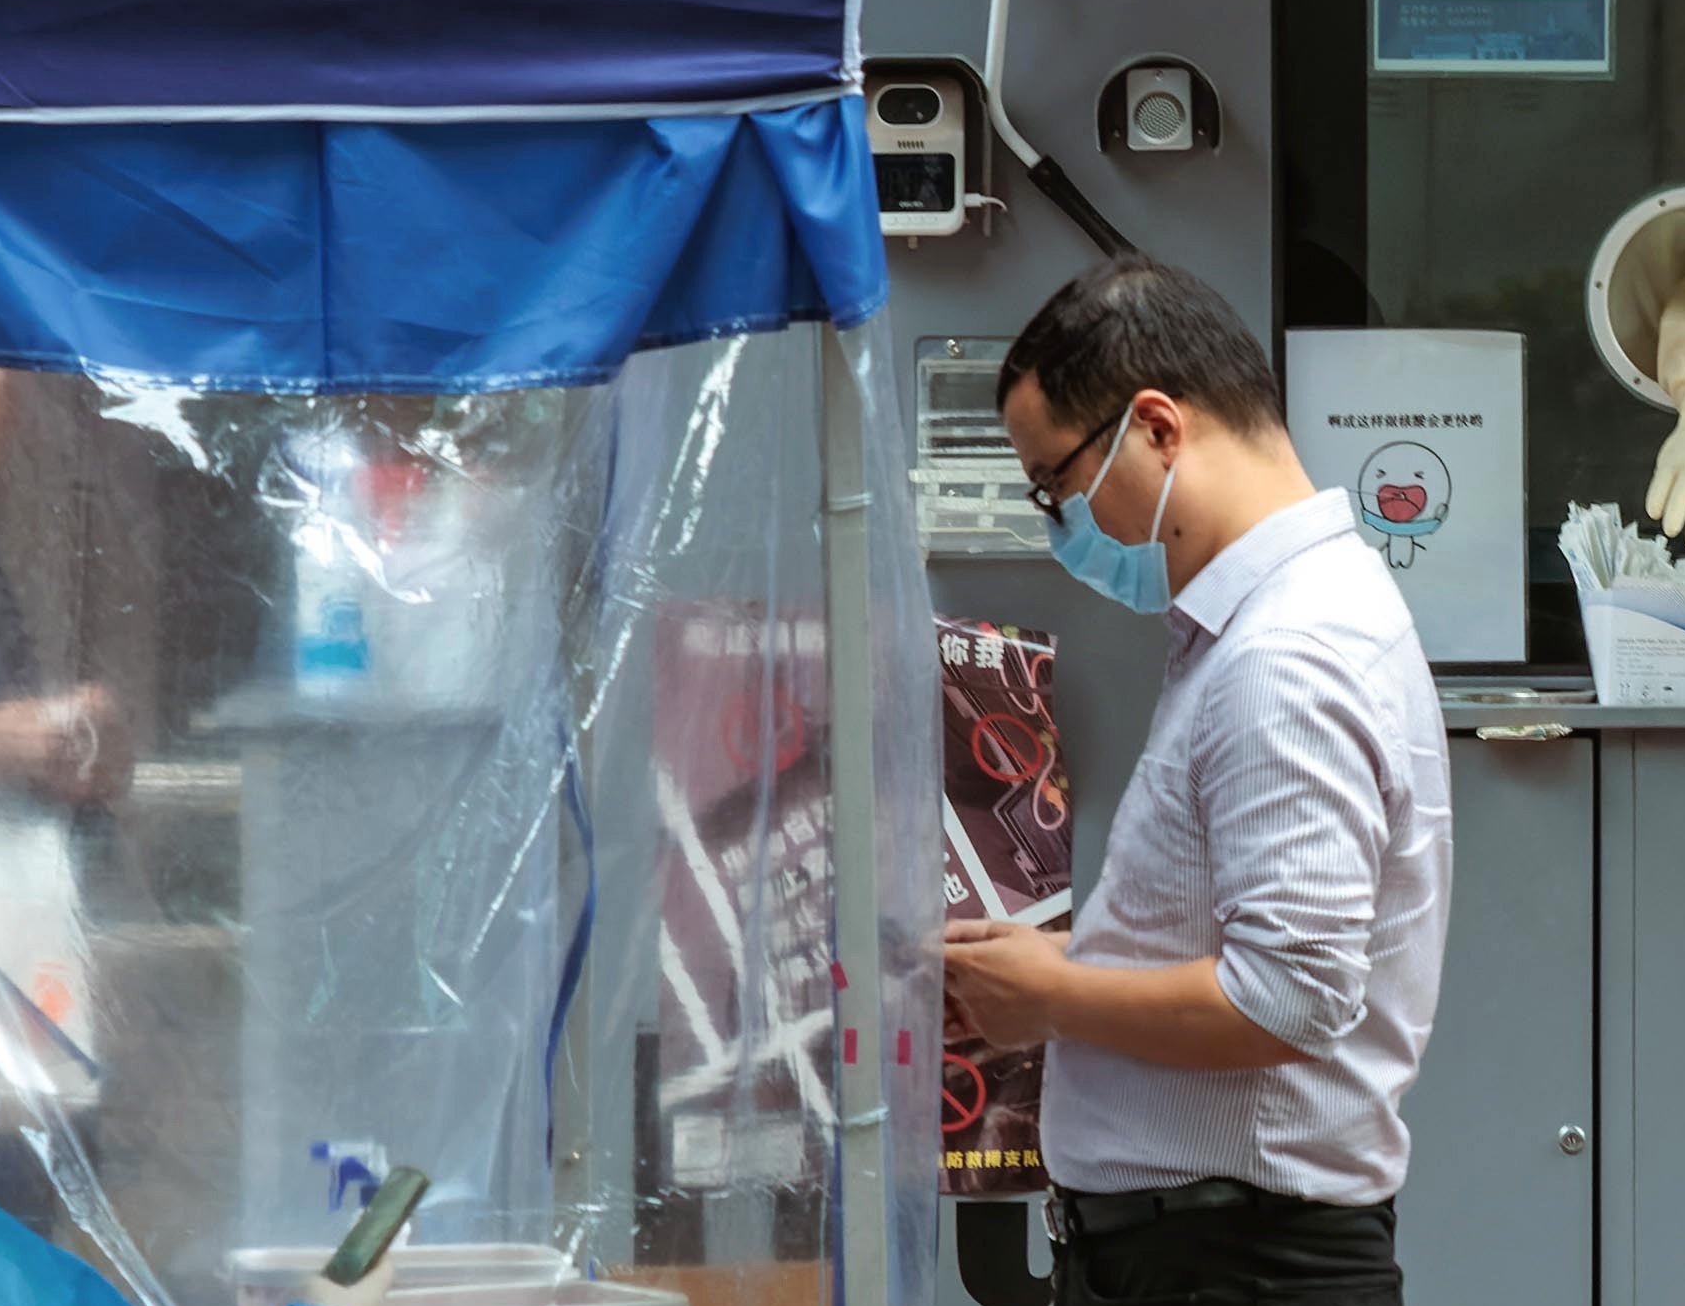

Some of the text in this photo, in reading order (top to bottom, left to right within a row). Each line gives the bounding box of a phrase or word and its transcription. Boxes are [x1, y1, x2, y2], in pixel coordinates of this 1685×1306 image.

[939, 1149, 1041, 1169] 防救援支队
